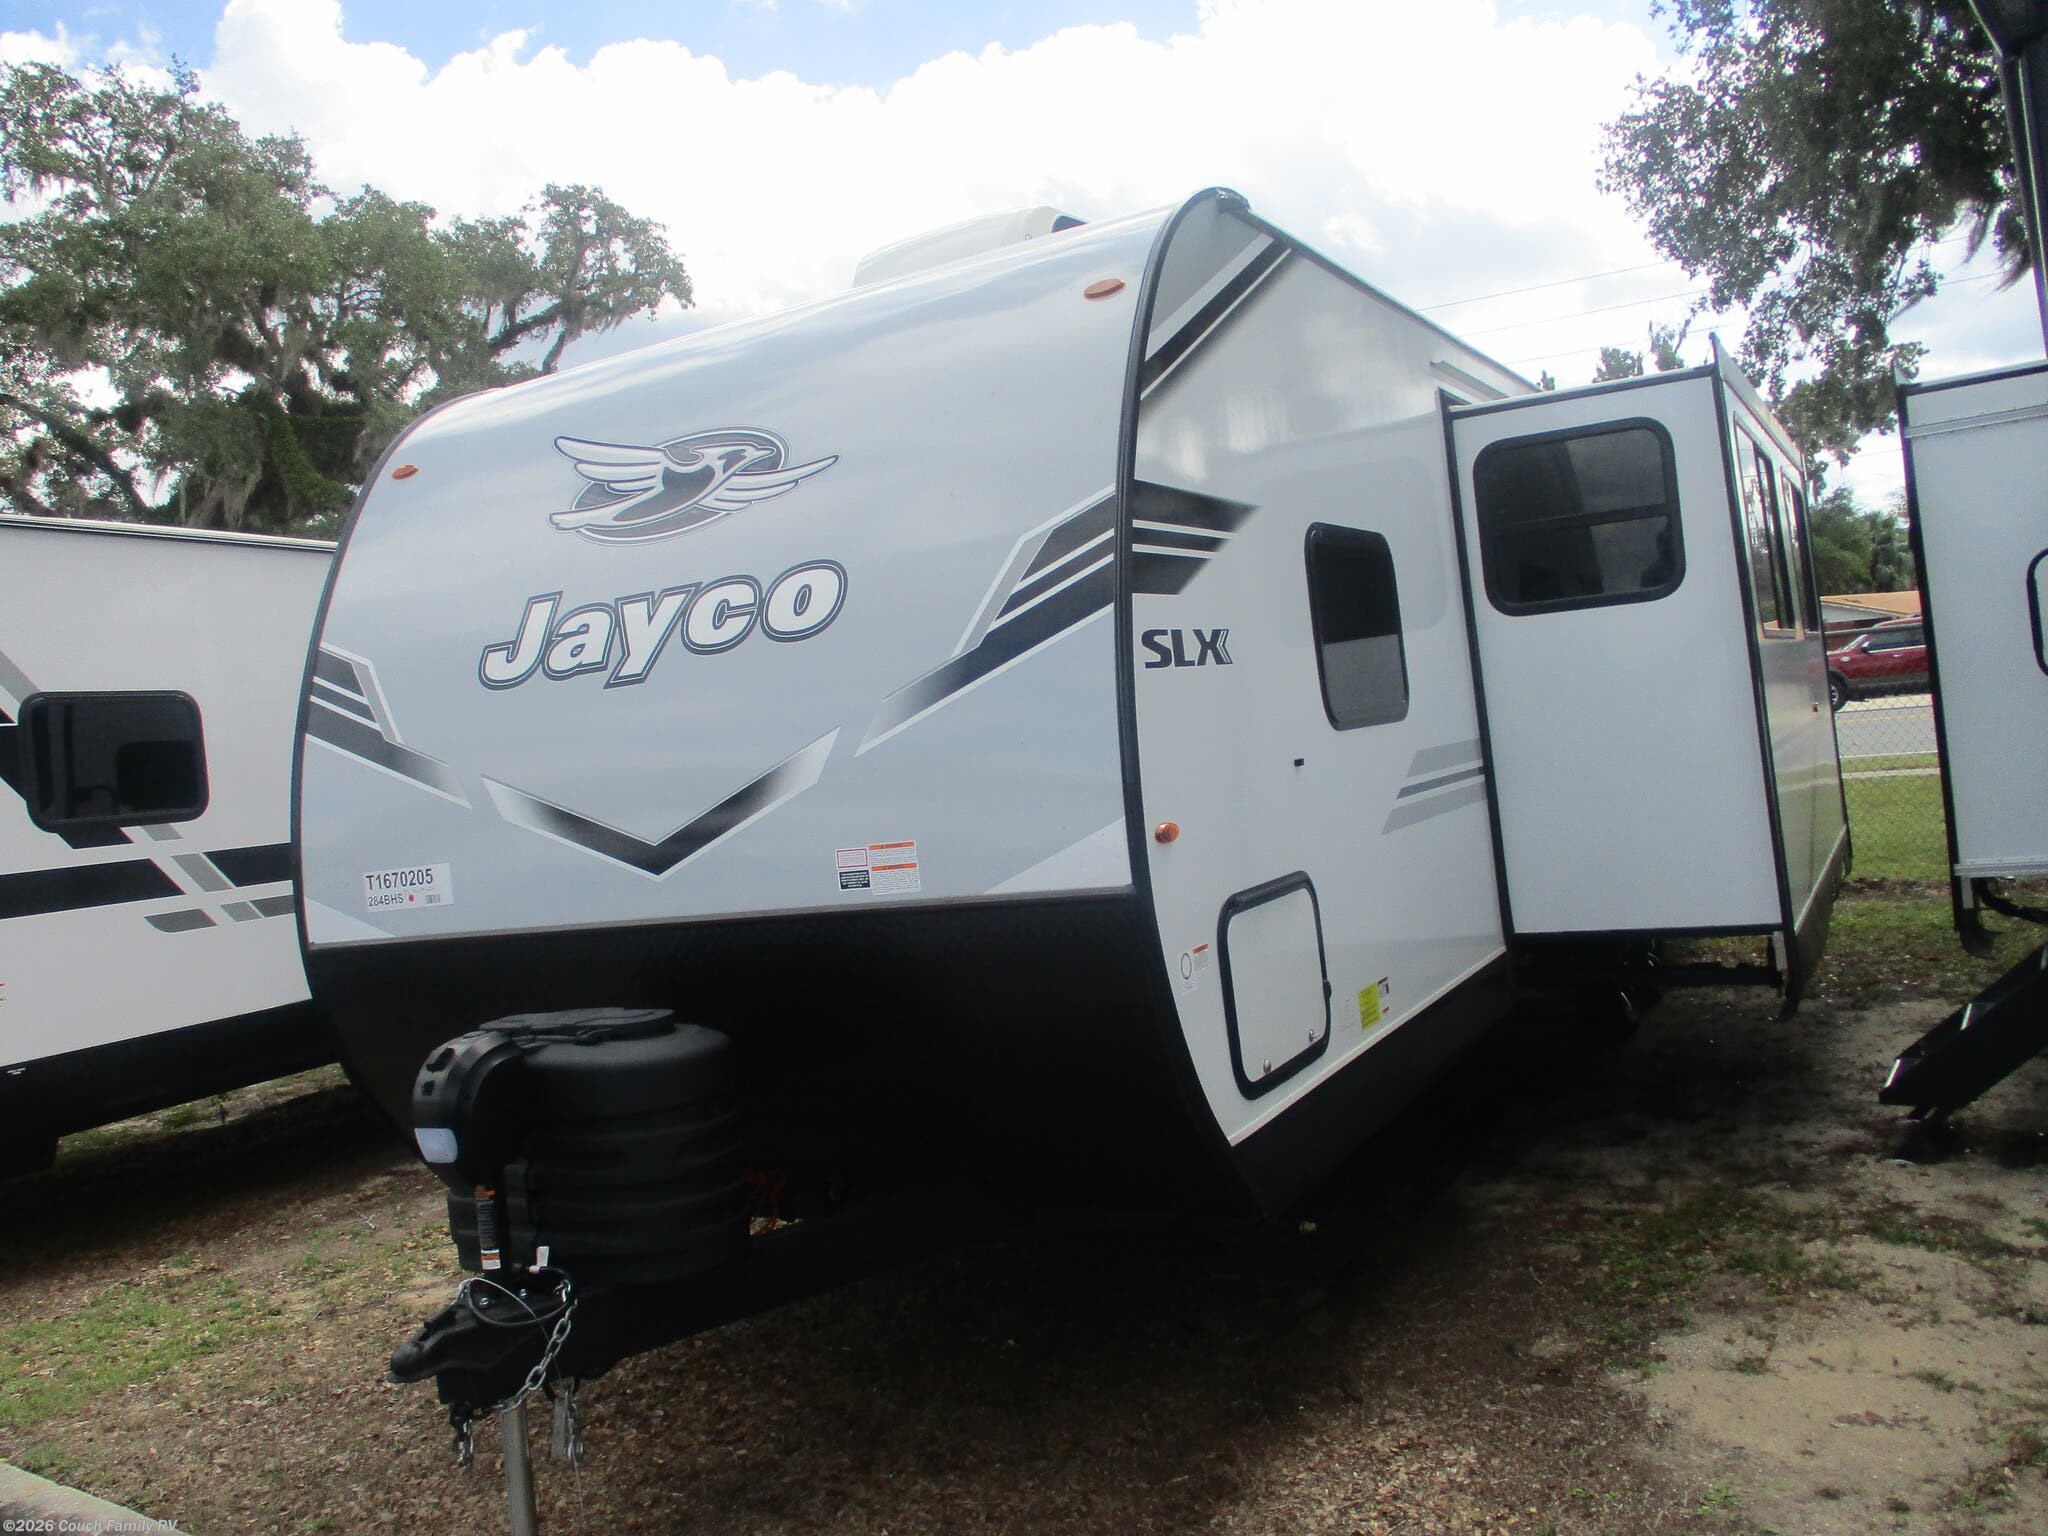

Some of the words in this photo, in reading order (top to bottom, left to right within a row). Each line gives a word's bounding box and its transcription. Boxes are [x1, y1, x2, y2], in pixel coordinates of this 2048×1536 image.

[478, 559, 848, 690] Jayco
[1141, 629, 1233, 669] SLX
[366, 868, 433, 890] T1670205
[368, 893, 404, 907] 284BHS
